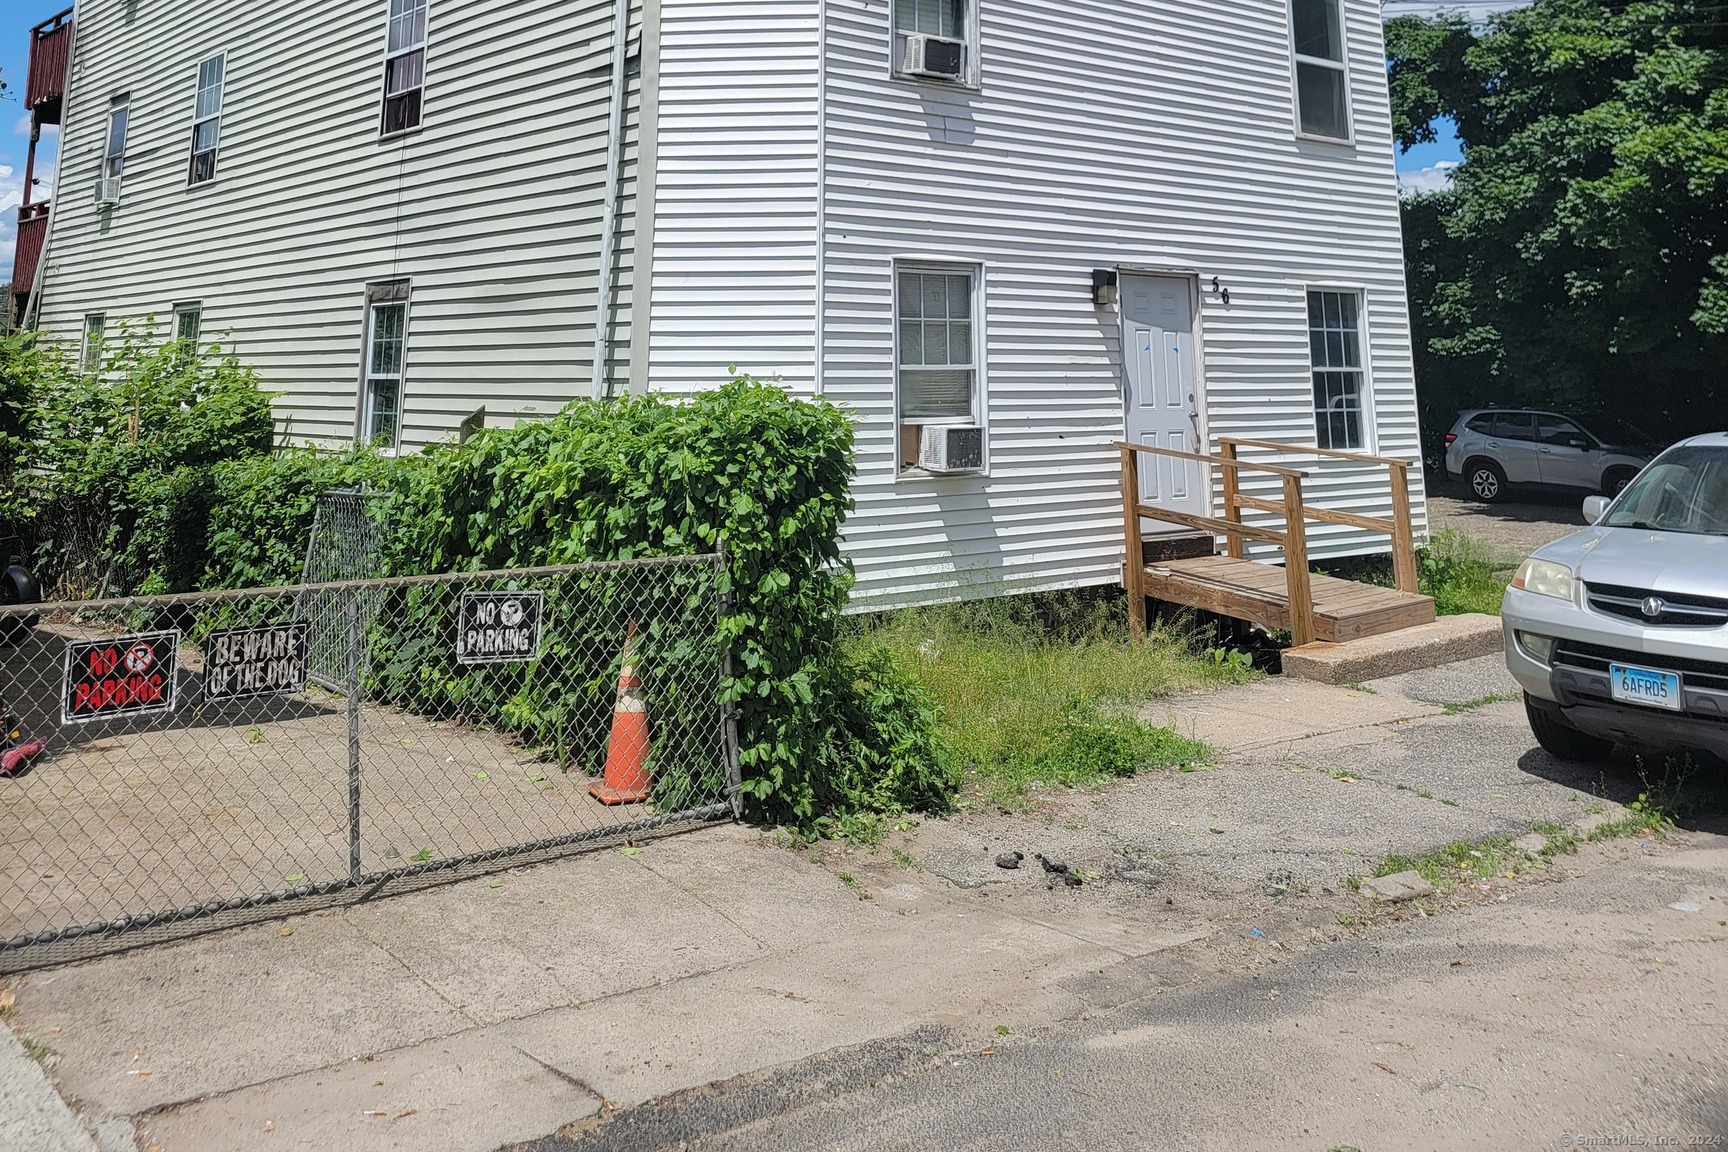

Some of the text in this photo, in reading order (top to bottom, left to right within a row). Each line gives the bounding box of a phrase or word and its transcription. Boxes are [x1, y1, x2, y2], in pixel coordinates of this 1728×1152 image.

[1212, 275, 1230, 305] 56
[475, 602, 496, 625] NO
[215, 628, 298, 664] BEWARE
[467, 628, 529, 653] PARKING
[89, 648, 117, 676] NO
[210, 658, 299, 694] OF THE DOG
[74, 673, 162, 712] PARKING
